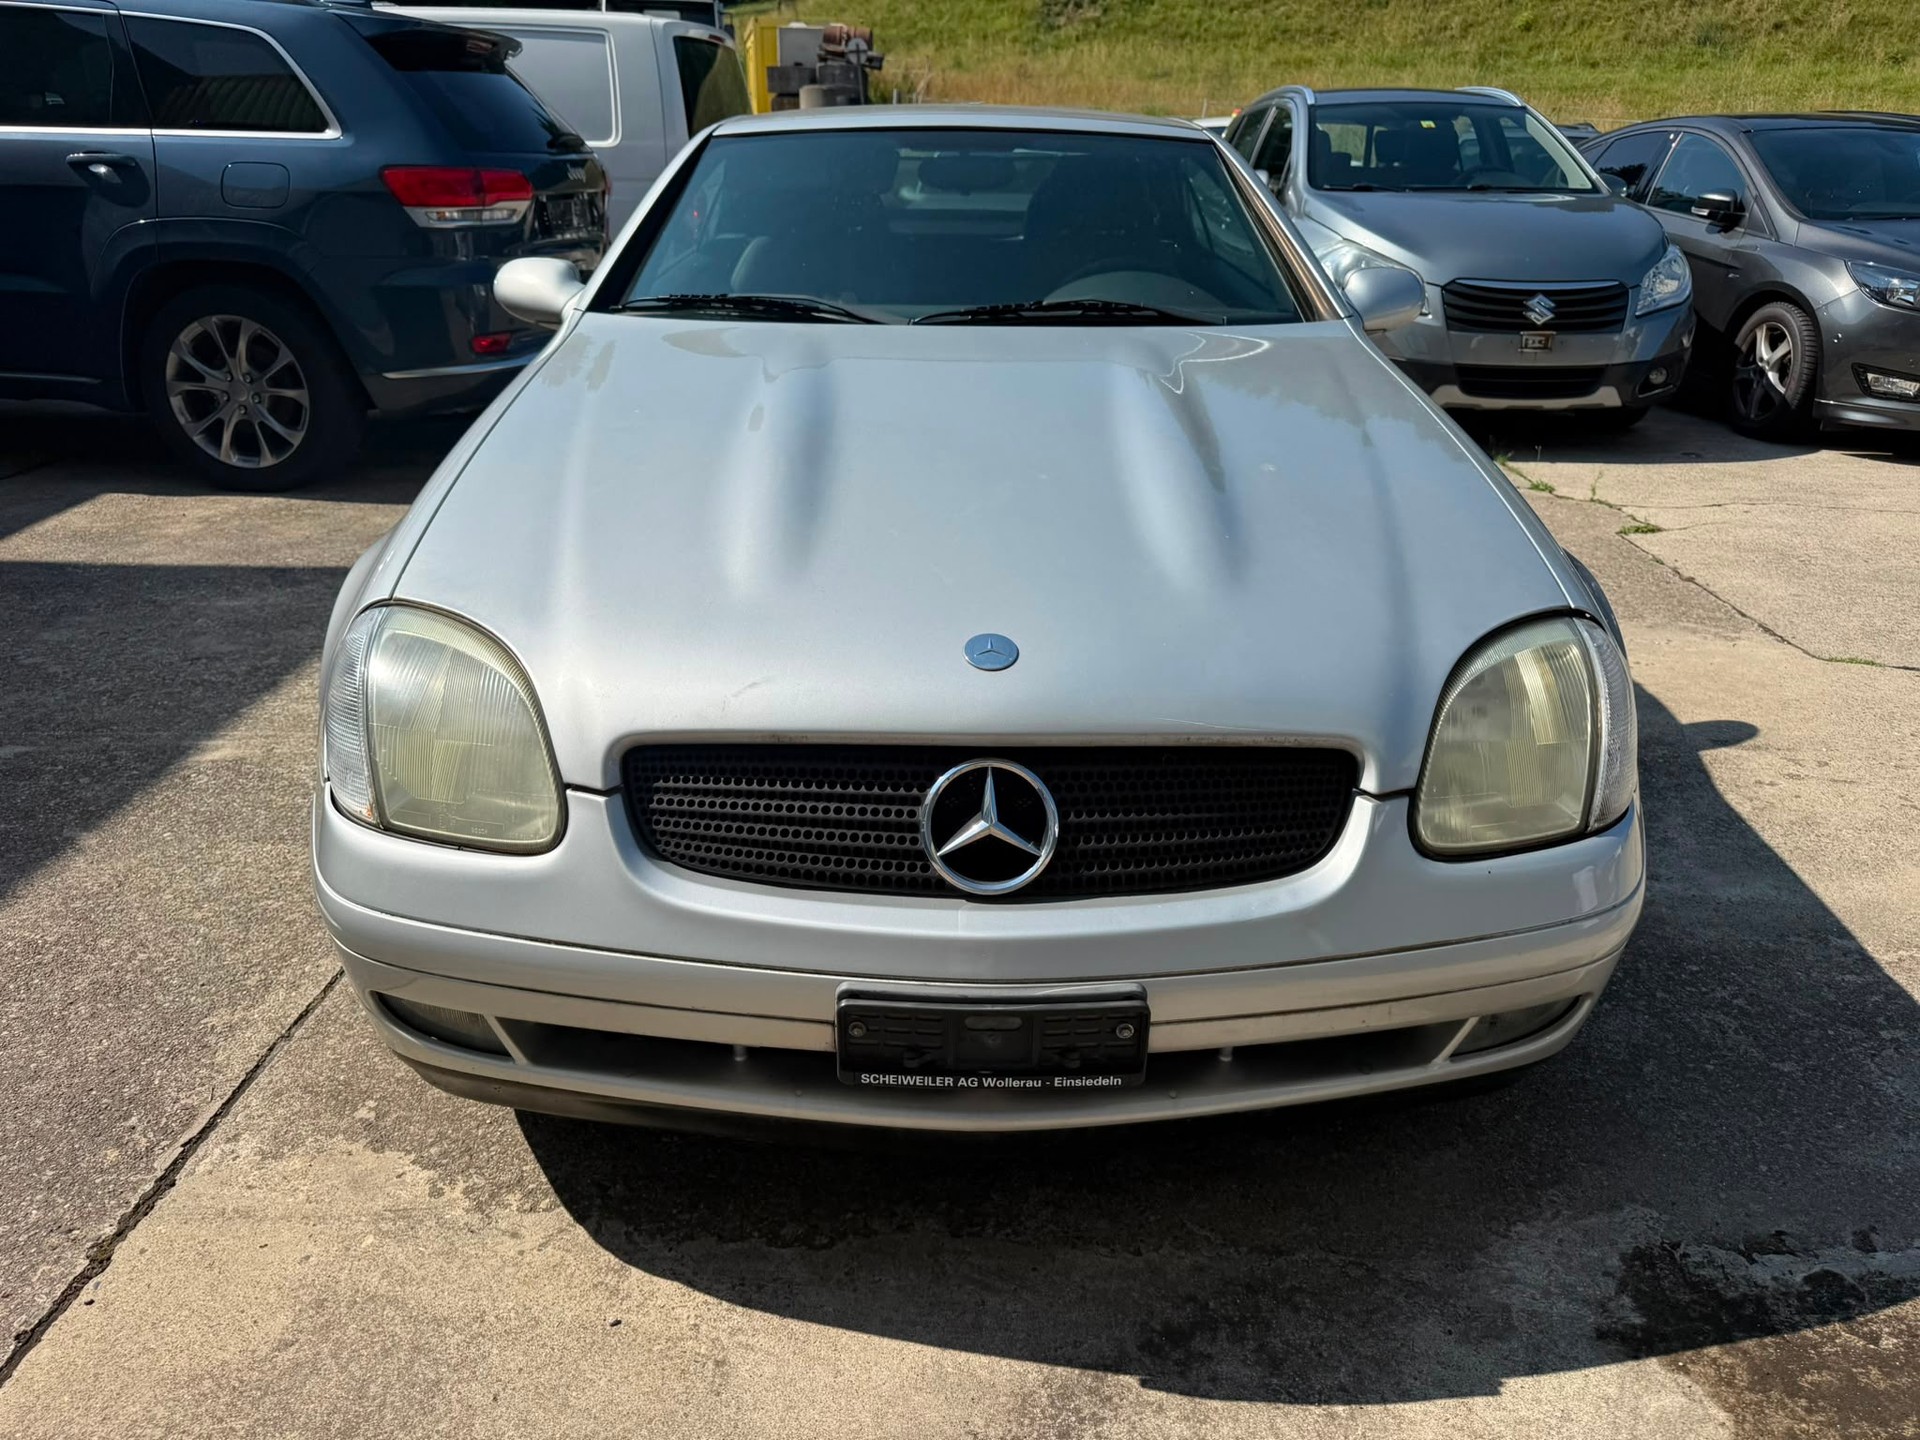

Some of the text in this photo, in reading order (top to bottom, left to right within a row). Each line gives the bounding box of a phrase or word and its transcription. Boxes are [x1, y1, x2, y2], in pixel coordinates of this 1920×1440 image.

[860, 1073, 954, 1087] SCHEIWEILER
[957, 1077, 979, 1088] AG
[982, 1077, 1042, 1088] Wollerau
[1054, 1076, 1122, 1087] Einsiedeln
